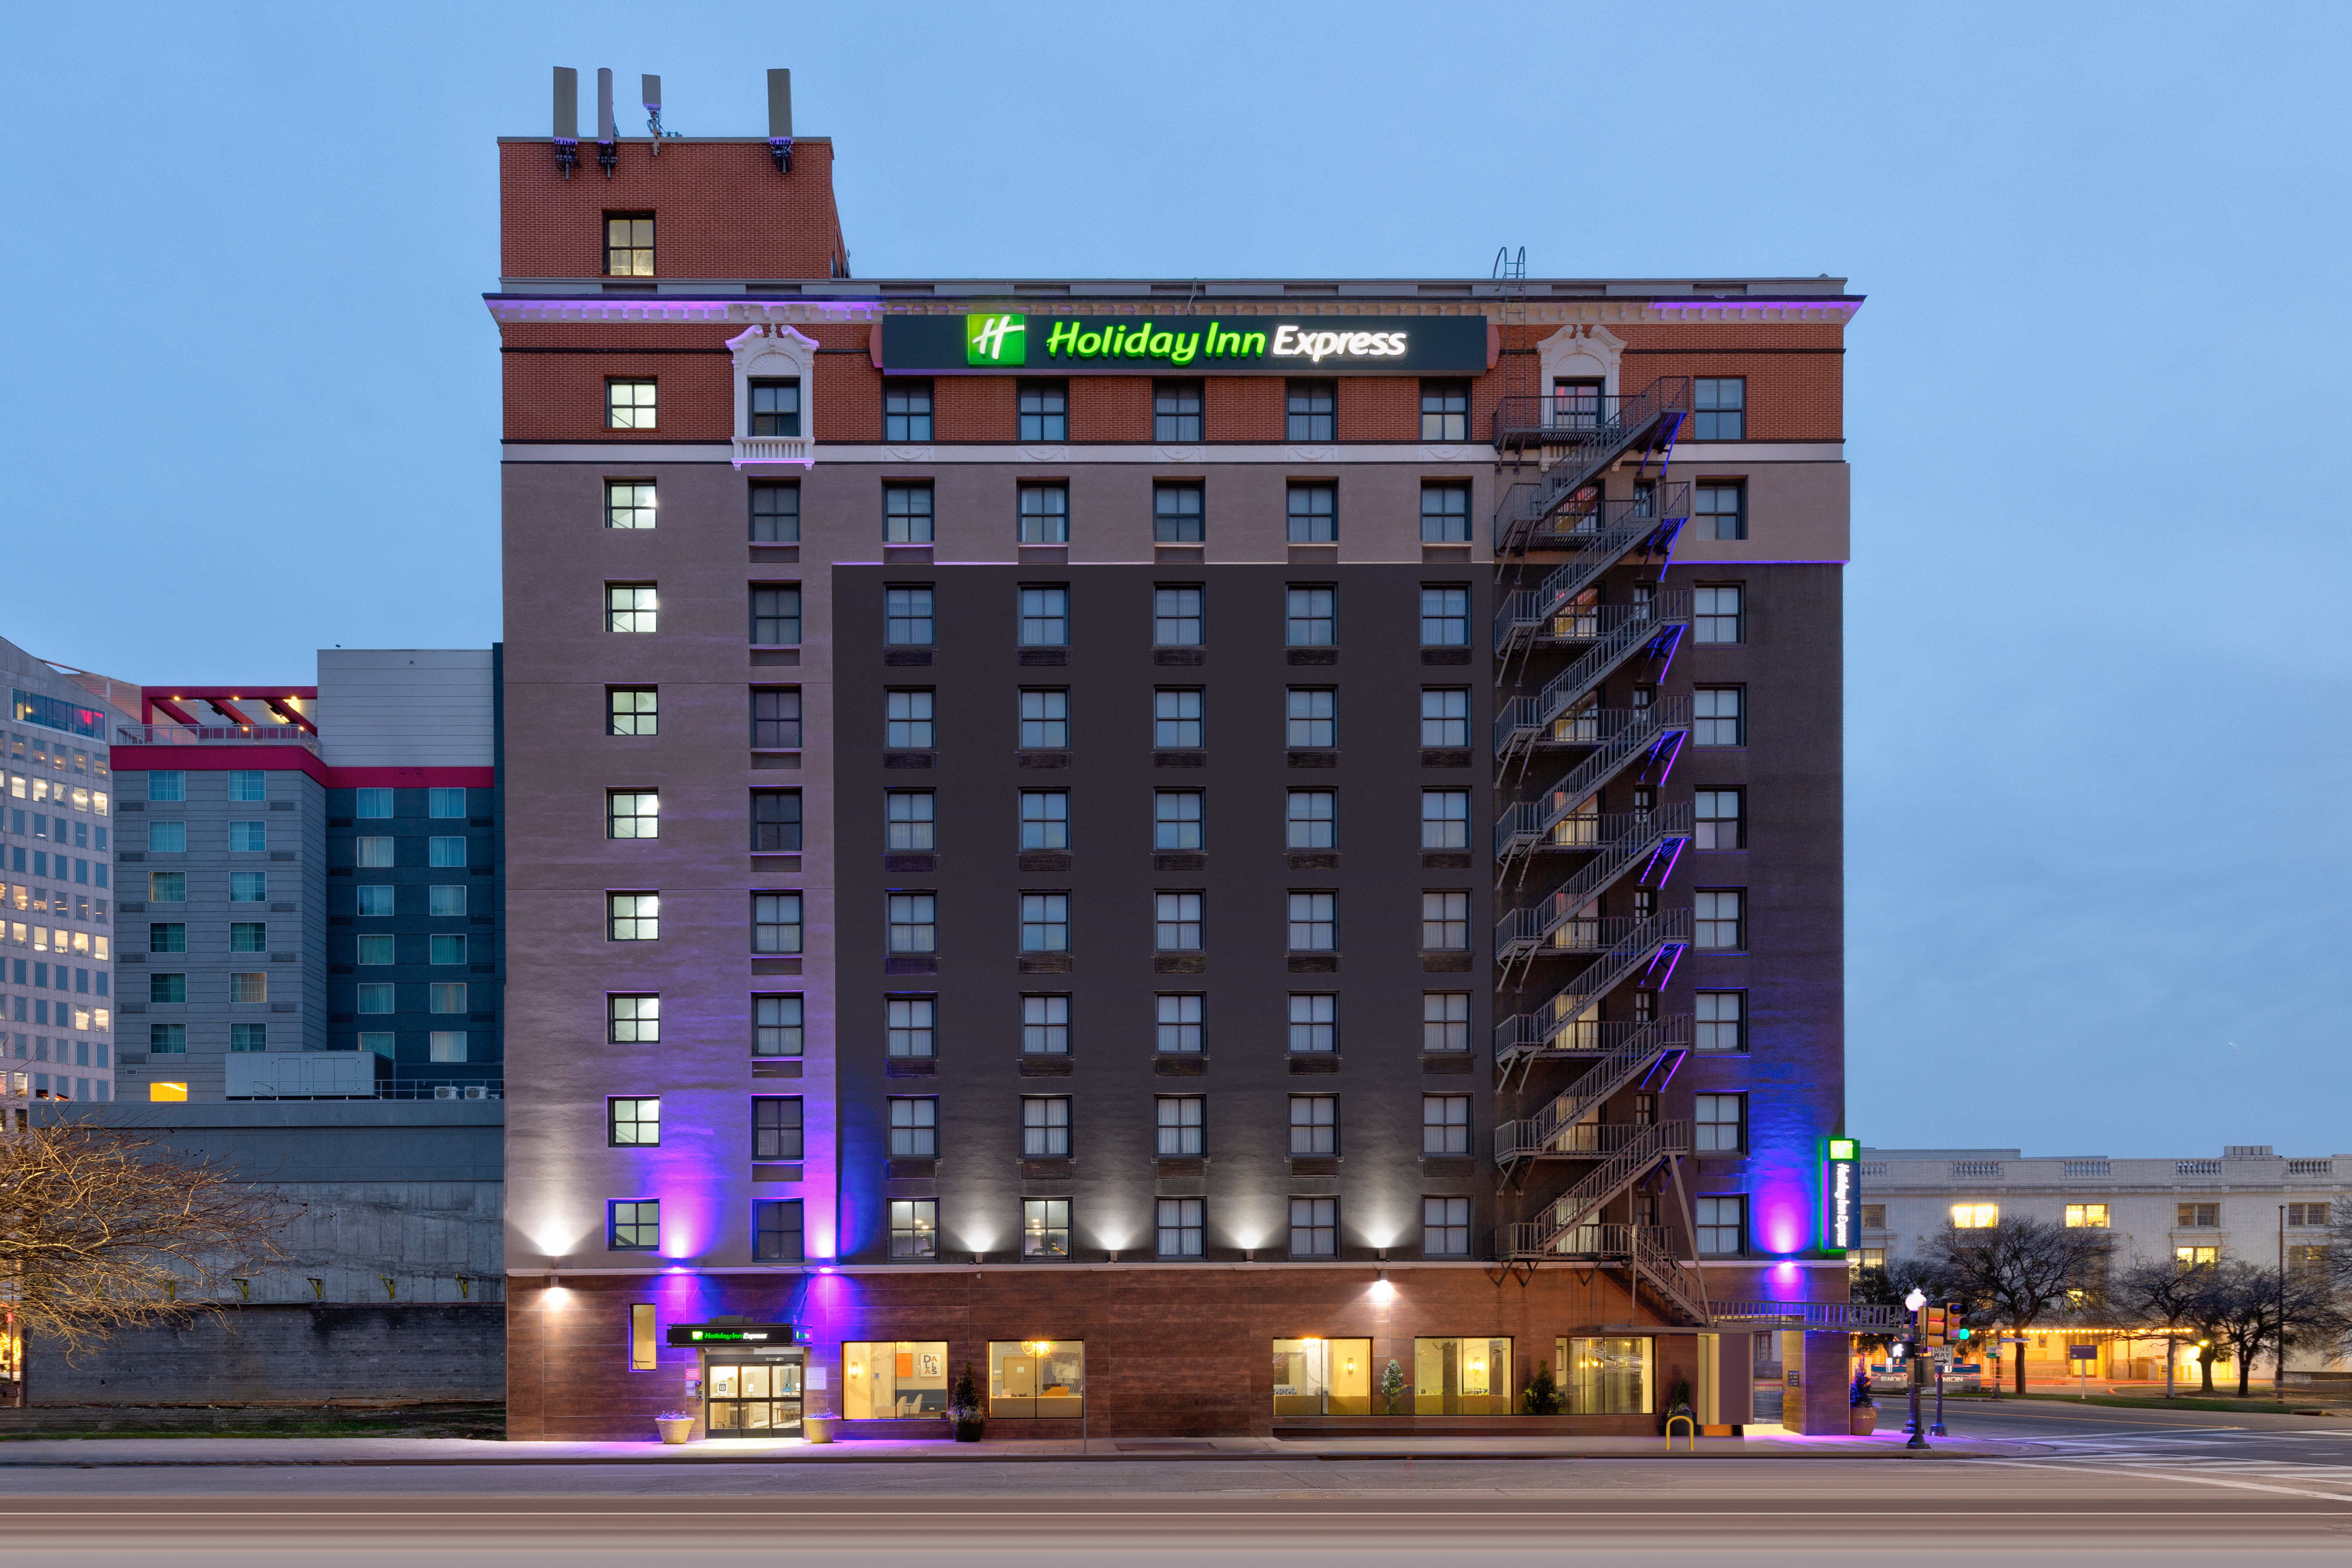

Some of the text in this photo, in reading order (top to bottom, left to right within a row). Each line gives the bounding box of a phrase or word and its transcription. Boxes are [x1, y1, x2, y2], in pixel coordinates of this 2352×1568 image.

[1047, 322, 1200, 364] Holiday
[1205, 322, 1265, 357] Inn
[1273, 325, 1406, 363] Express
[1835, 1163, 1850, 1247] Holiday Inn Express
